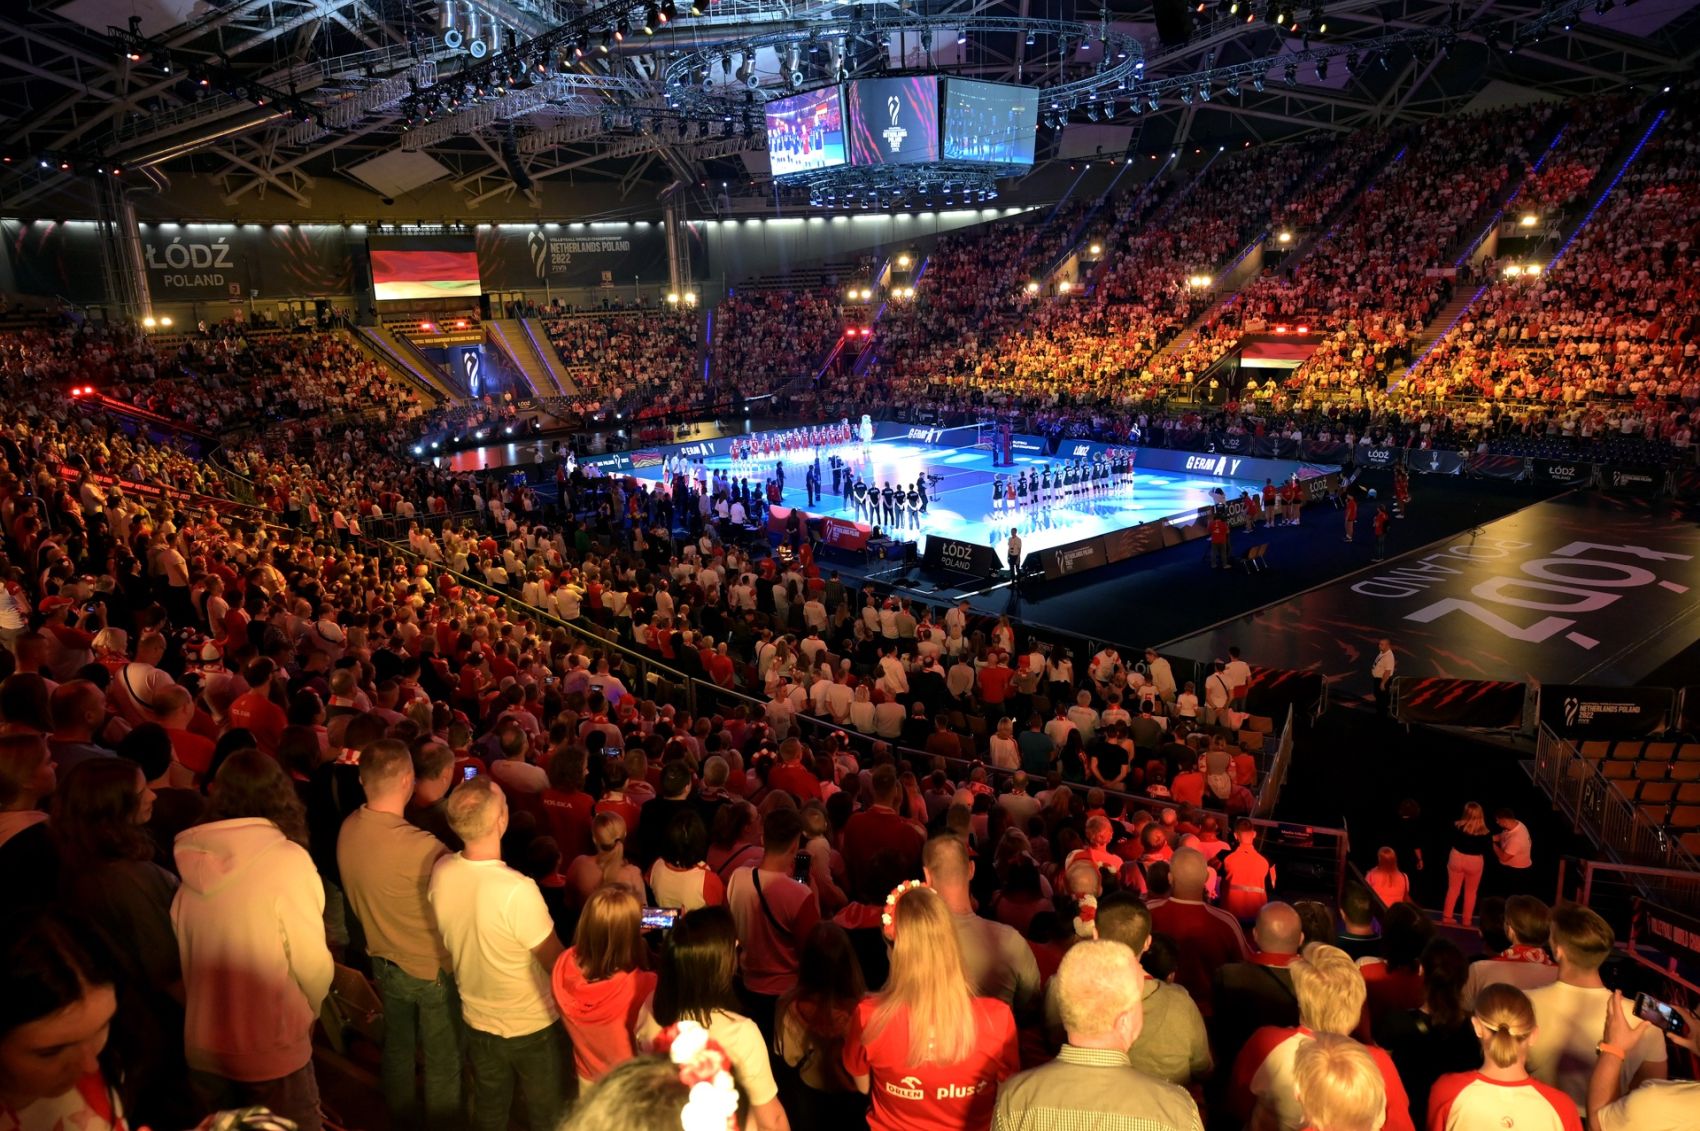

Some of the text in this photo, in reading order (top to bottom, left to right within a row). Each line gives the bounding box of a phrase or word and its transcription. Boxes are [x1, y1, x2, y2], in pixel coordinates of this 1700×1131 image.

[145, 237, 234, 269] ŁÓDŹ
[550, 240, 630, 254] NETHERLANDS POLAND
[551, 253, 572, 265] 2022
[163, 274, 225, 287] POLAND
[1548, 465, 1576, 477] ŁÓDŹ
[942, 541, 973, 560] ŁÓDŹ
[941, 556, 971, 570] POLAND
[1350, 537, 1533, 598] POLAND
[1402, 541, 1694, 650] ŁÓDŹ
[1580, 705, 1618, 713] NETHERLANDS
[887, 1083, 975, 1100] ORLEN plus
